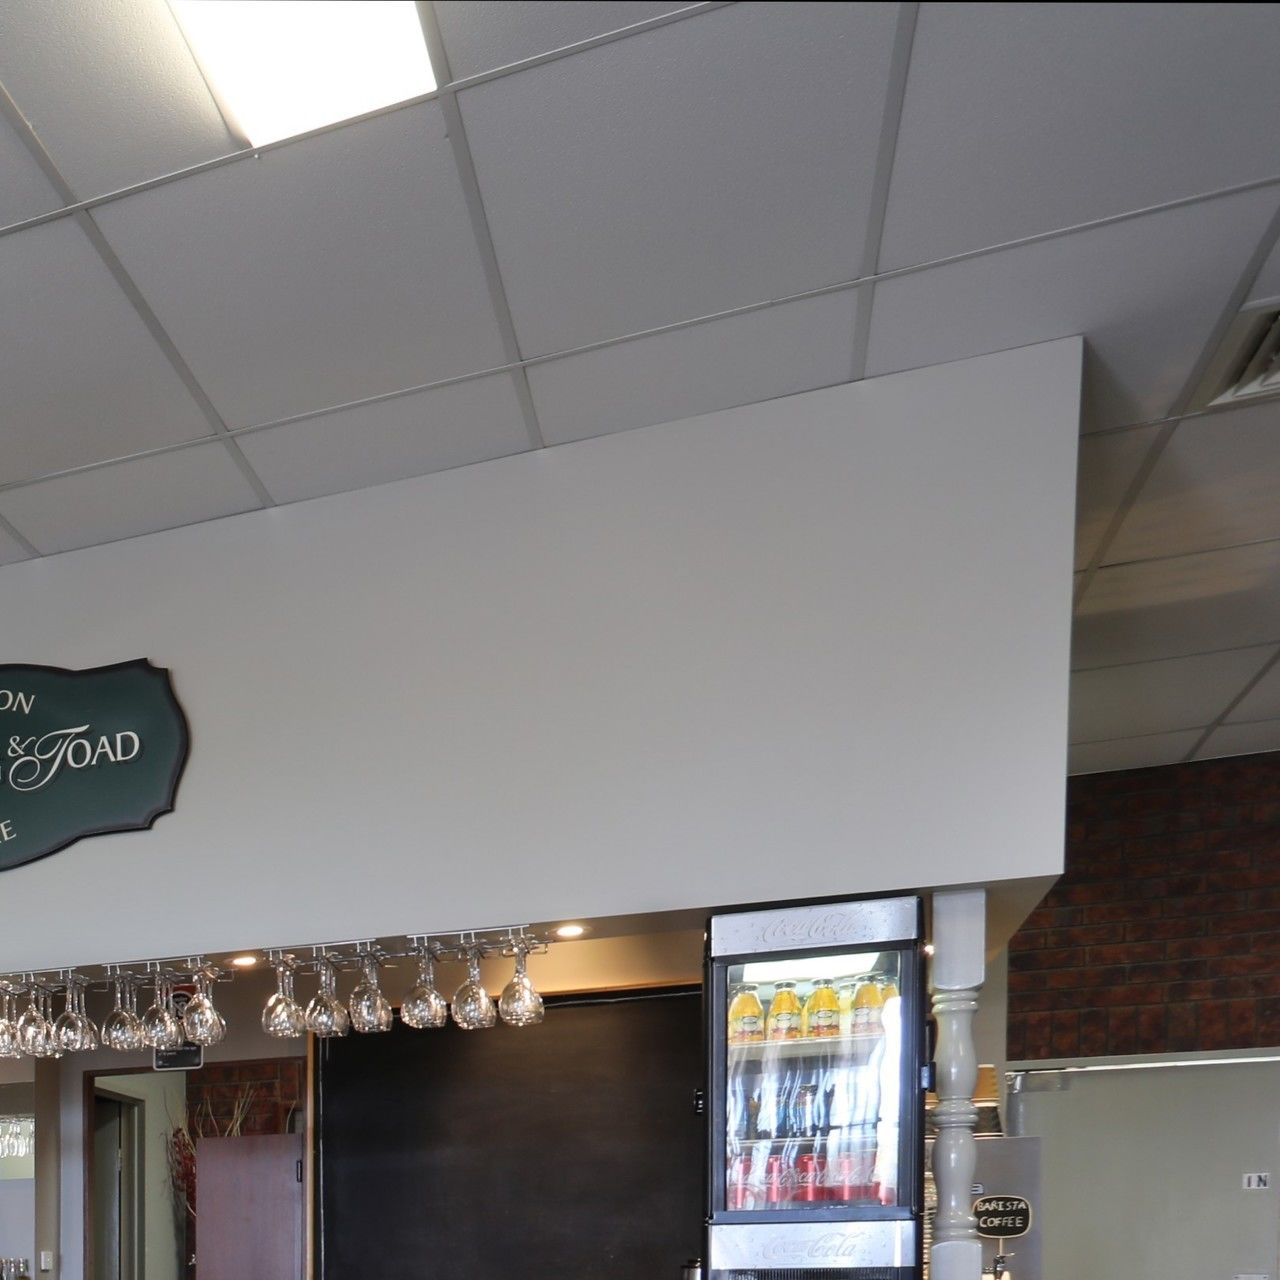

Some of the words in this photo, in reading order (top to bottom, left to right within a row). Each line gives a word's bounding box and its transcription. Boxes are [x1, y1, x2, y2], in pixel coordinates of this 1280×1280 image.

[7, 735, 37, 757] &
[9, 724, 140, 792] TOAD
[1247, 1174, 1268, 1188] IN
[976, 1200, 1028, 1211] BARISTA
[979, 1216, 1024, 1228] COFFEE
